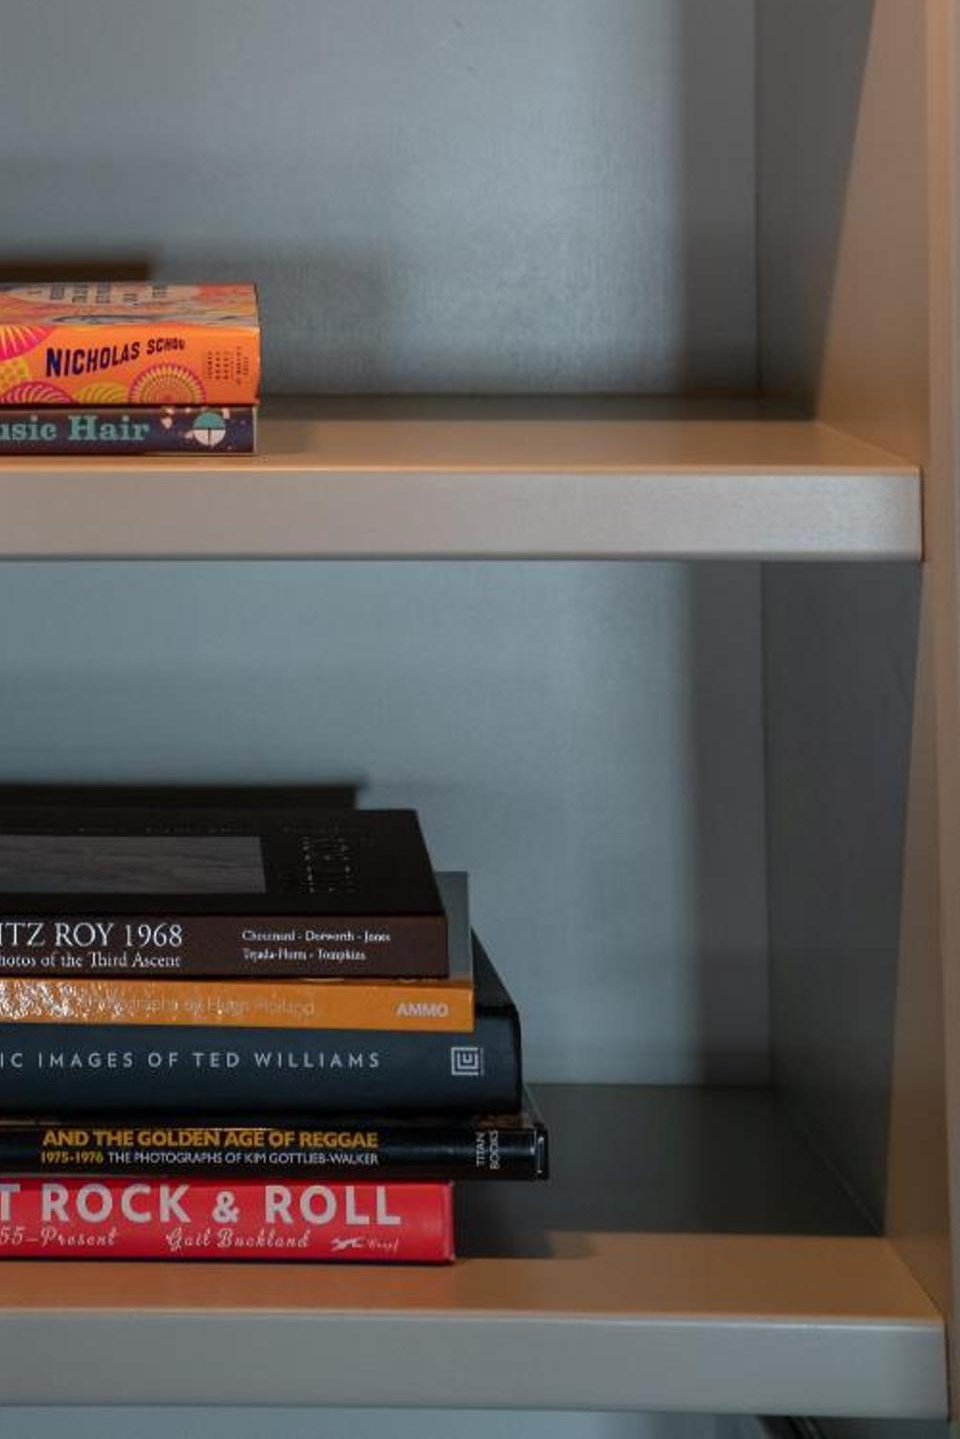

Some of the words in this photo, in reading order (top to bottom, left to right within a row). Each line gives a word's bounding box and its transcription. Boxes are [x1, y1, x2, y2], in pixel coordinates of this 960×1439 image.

[45, 341, 141, 378] NICHOLAS
[67, 415, 151, 442] Hair
[54, 922, 115, 947] ROY
[124, 923, 184, 948] 1968
[363, 929, 392, 944] Jones
[40, 952, 59, 968] of
[60, 952, 83, 968] the
[89, 951, 128, 969] Third
[131, 952, 182, 969] Ascent
[395, 1002, 450, 1018] AMMO
[38, 1052, 135, 1069] IMAGES
[147, 1052, 180, 1069] OF
[192, 1052, 240, 1069] TED
[253, 1052, 382, 1069] WILLIAMS
[42, 1129, 89, 1147] AND
[93, 1129, 134, 1147] THE
[137, 1130, 220, 1147] GOLDEN
[223, 1130, 265, 1147] AGE
[268, 1130, 295, 1147] OF
[299, 1131, 379, 1148] REGGAE
[475, 1131, 486, 1168] TITAN
[489, 1129, 500, 1171] BOOKS
[41, 1150, 105, 1164] 1975-1976
[108, 1151, 131, 1164] THE
[133, 1151, 223, 1164] PHOTOGRAPHS
[224, 1151, 243, 1164] OF
[244, 1151, 267, 1164] KIM
[268, 1152, 379, 1166] GOTTLIEB-WALKER
[41, 1182, 191, 1223] ROCK
[212, 1190, 240, 1224] &
[265, 1184, 402, 1225] ROLL
[165, 1226, 212, 1253] Gail
[216, 1227, 311, 1250] Buckland
